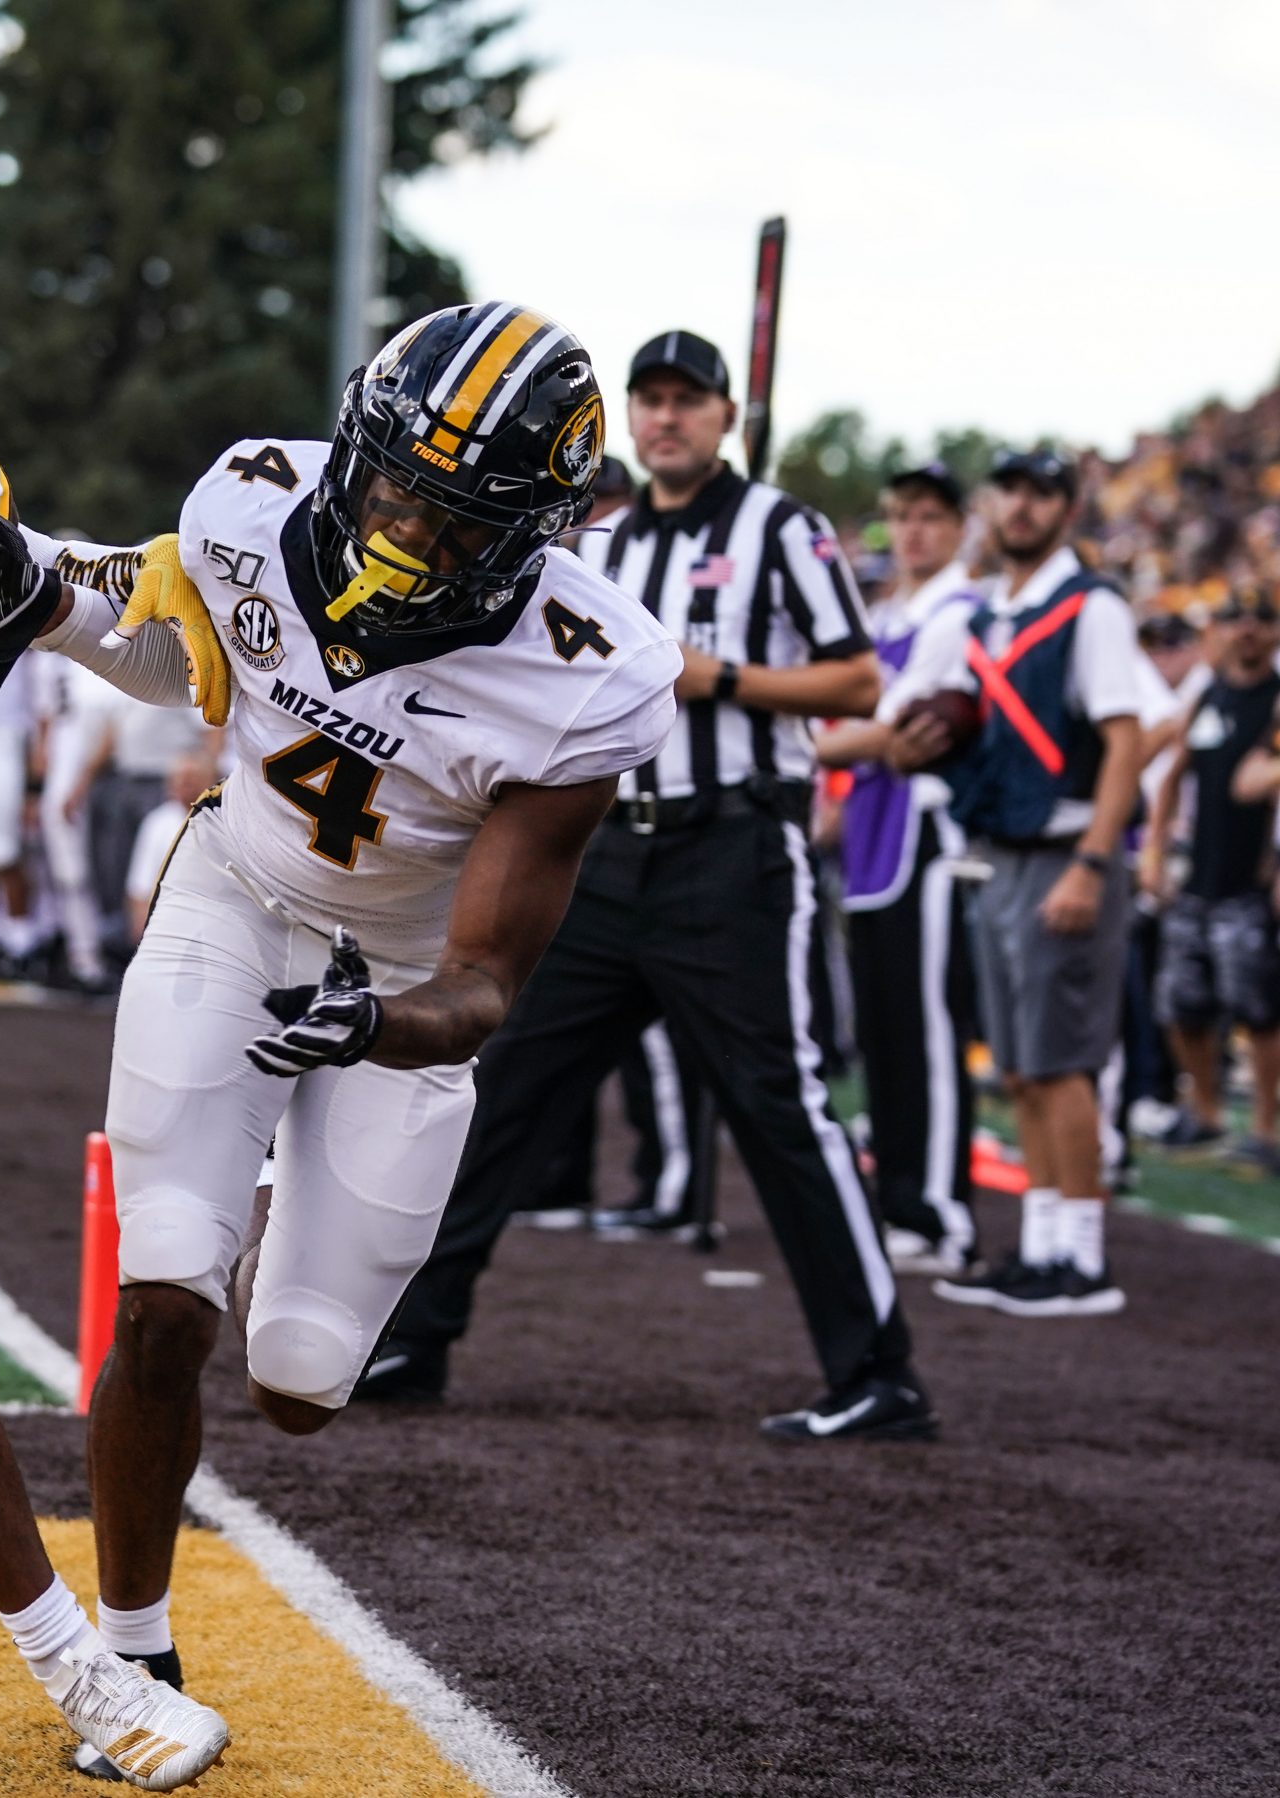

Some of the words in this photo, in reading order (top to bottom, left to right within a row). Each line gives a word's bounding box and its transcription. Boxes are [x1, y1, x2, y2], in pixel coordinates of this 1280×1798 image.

[225, 445, 301, 493] 4
[411, 441, 459, 473] TIGERS
[201, 538, 265, 589] 150
[237, 599, 276, 652] SEC
[541, 595, 618, 664] 4
[230, 636, 277, 669] GRADUATE
[269, 678, 405, 760] MIZZOU
[262, 731, 389, 872] 4
